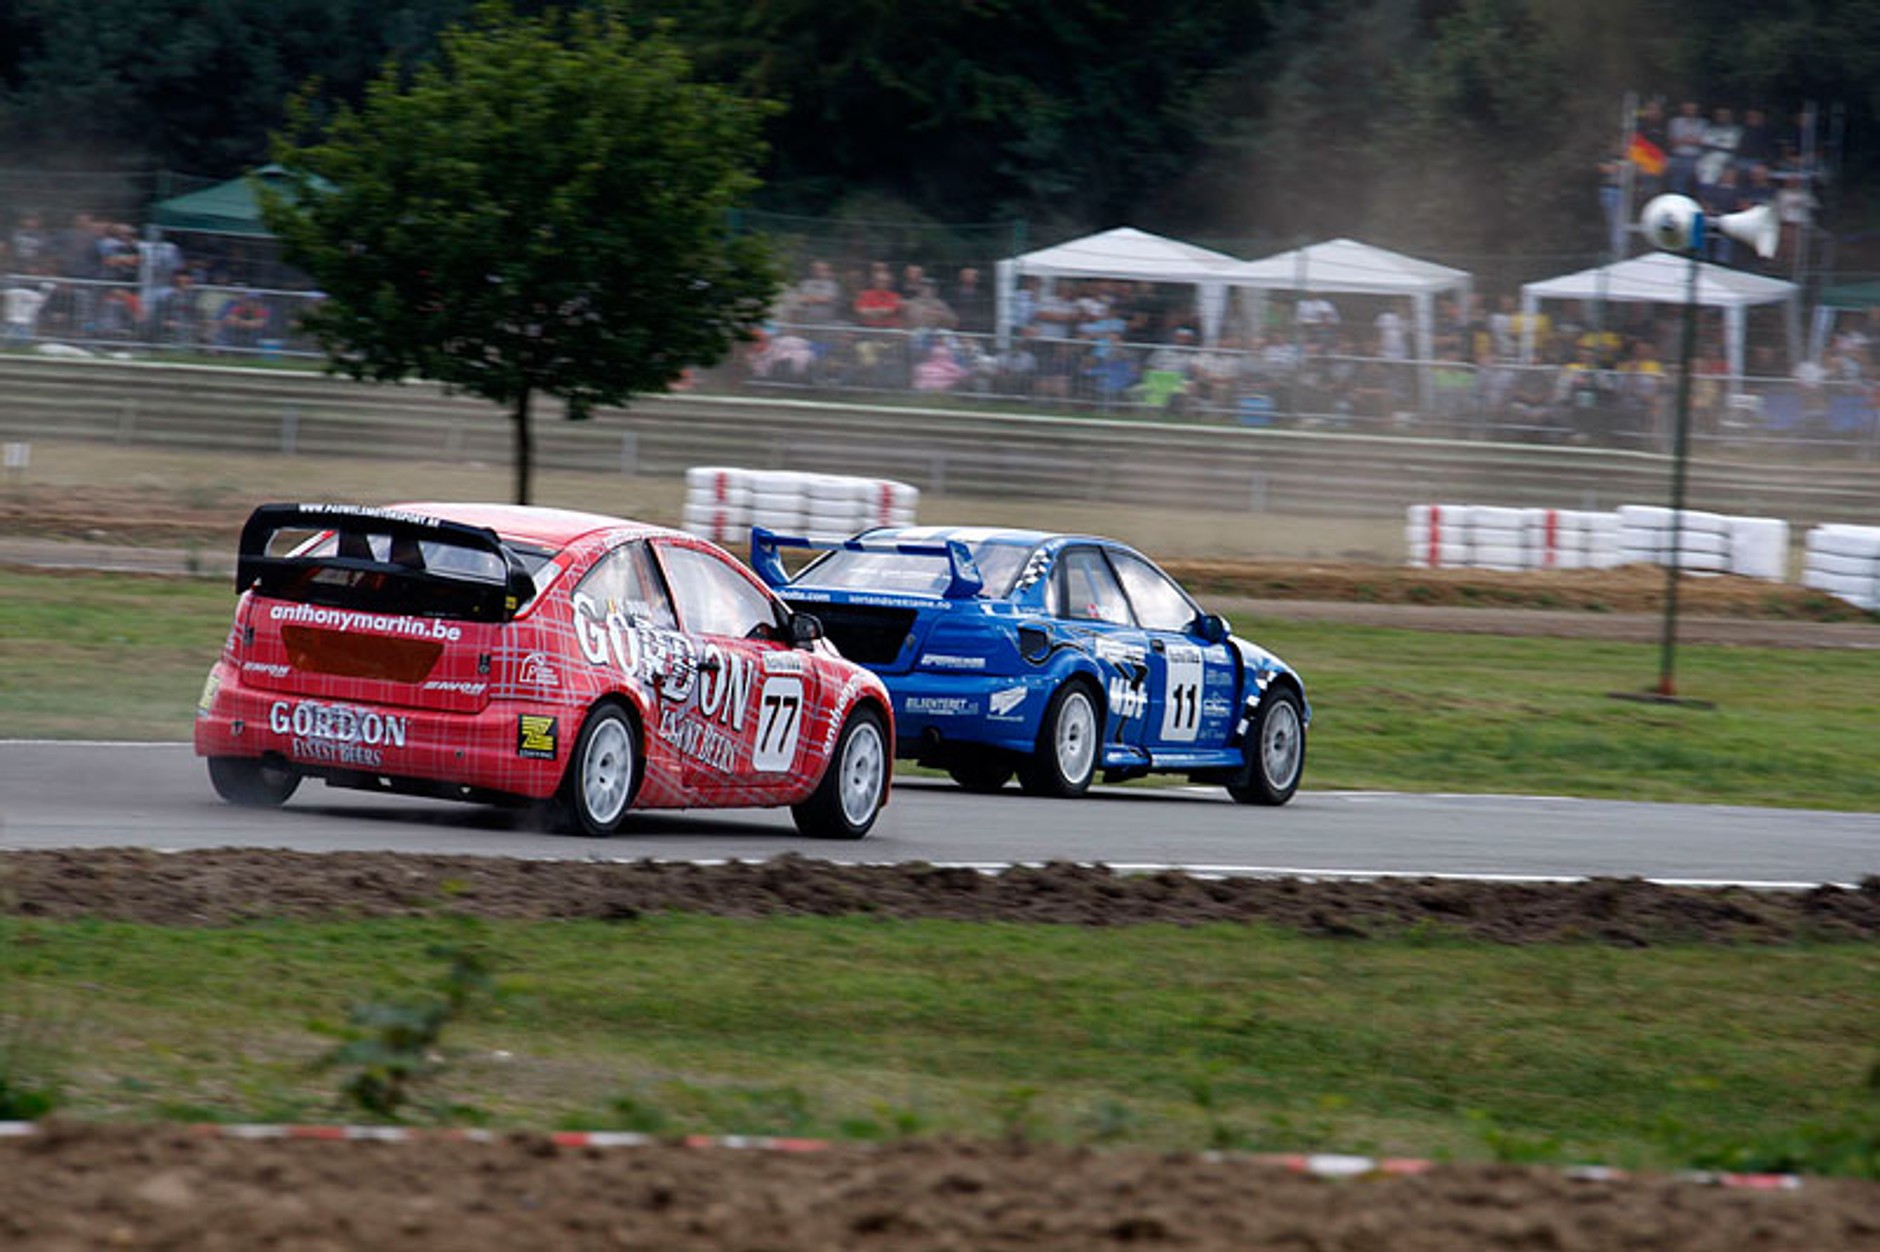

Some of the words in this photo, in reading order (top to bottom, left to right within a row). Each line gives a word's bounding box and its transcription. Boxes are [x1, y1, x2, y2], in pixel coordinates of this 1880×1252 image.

[270, 603, 462, 640] anthonymartin.be
[270, 701, 407, 747] GORDON
[760, 694, 798, 754] 77
[1173, 683, 1197, 728] 11
